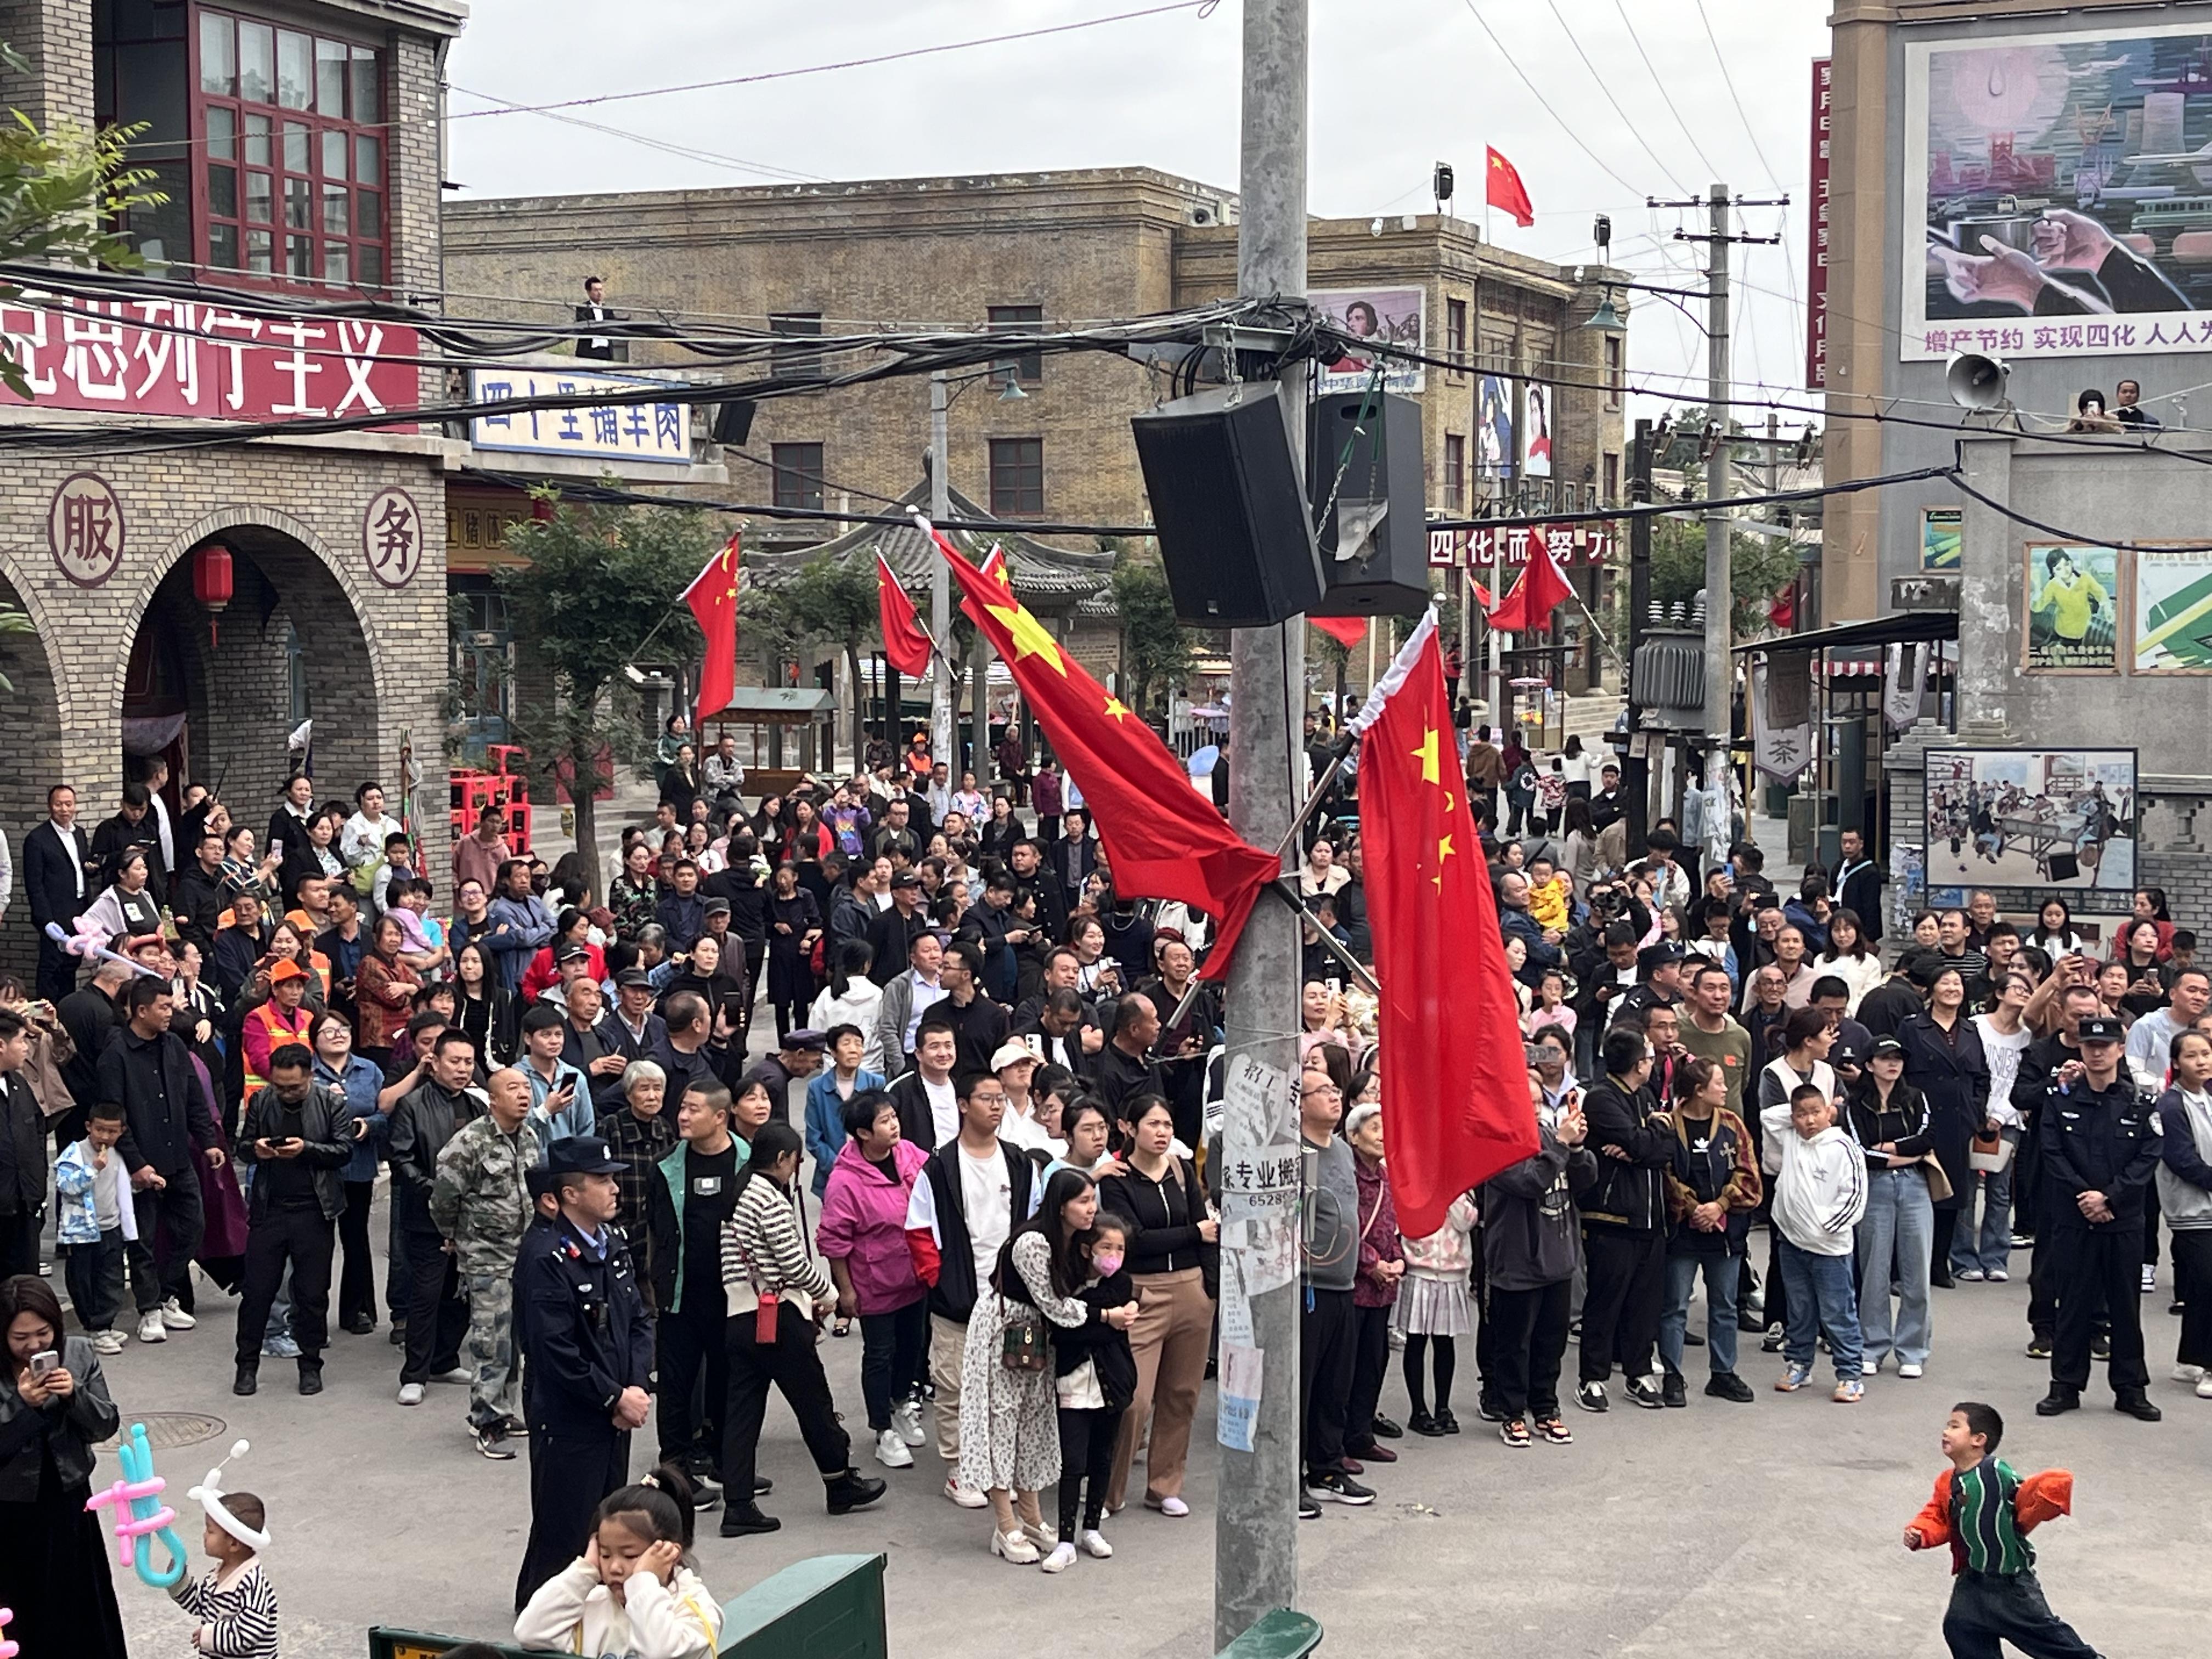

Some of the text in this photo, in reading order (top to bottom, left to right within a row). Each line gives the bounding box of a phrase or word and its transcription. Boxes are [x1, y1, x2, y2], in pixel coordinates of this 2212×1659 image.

[1925, 329, 2024, 353] 增产节约
[2034, 324, 2135, 349] 实现四化
[64, 494, 413, 575] 服 务
[1430, 528, 1612, 564] 四化而努力
[1891, 695, 1911, 714] 茶
[1768, 739, 1799, 764] 茶
